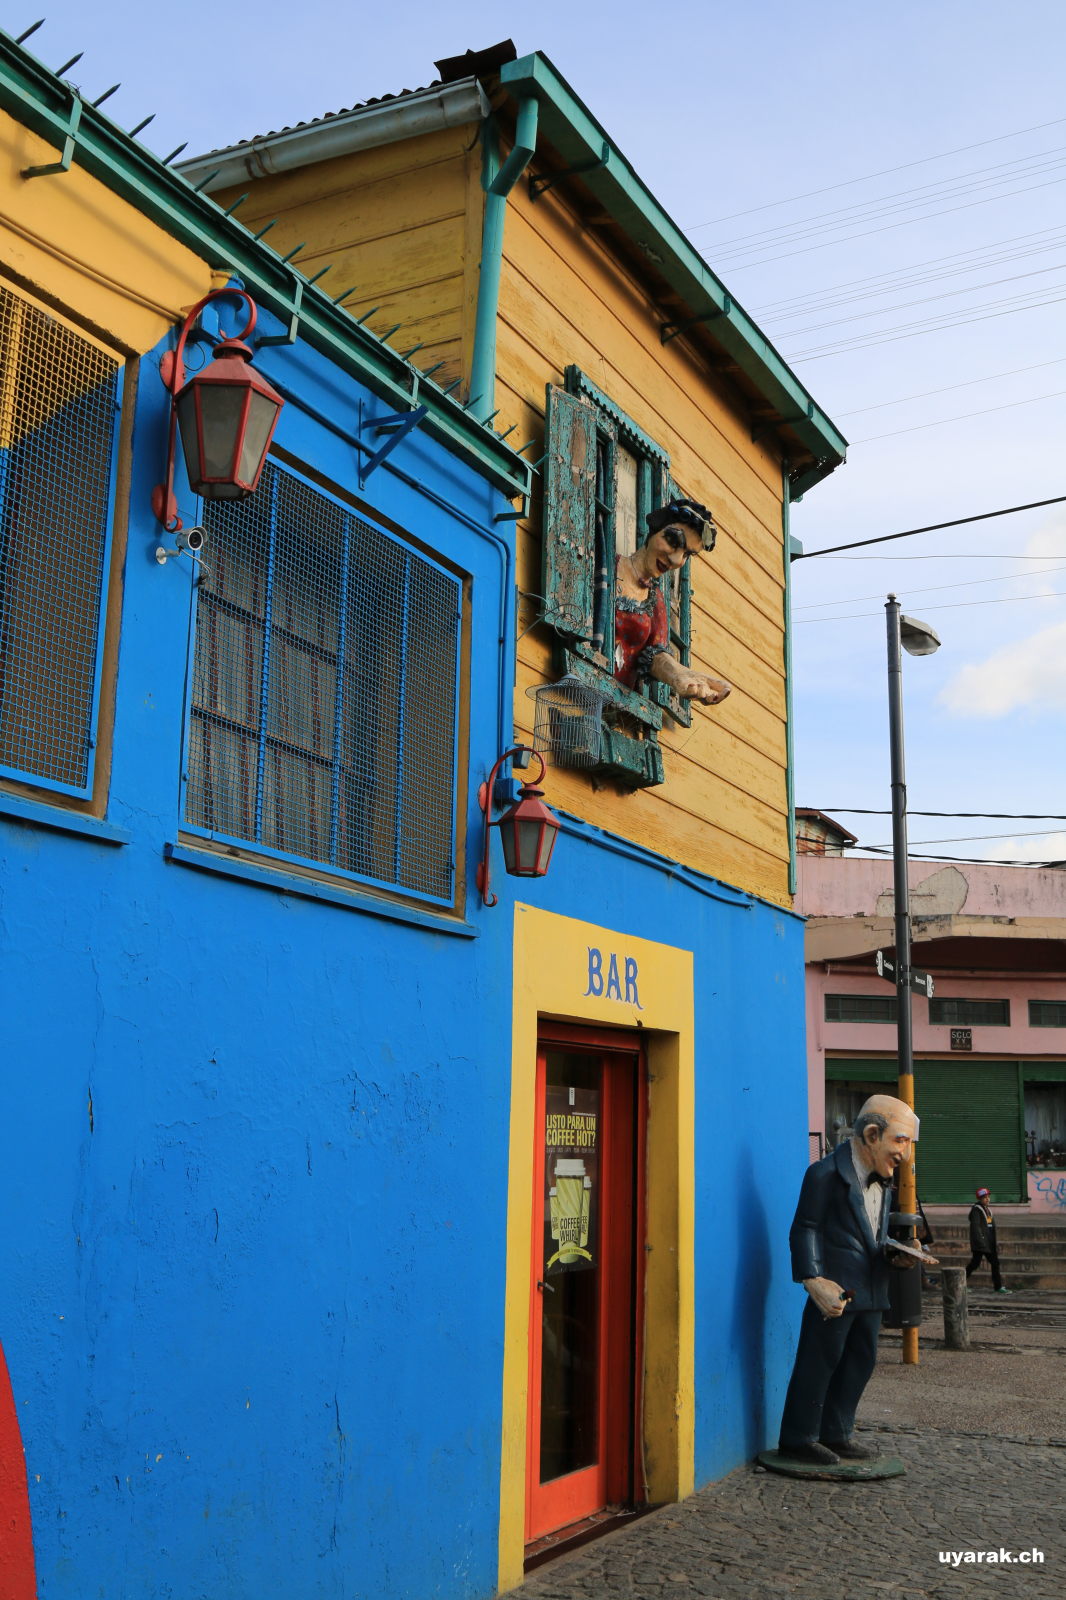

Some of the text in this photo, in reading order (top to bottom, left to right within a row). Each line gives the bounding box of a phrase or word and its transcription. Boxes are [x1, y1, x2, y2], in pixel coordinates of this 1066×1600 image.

[583, 946, 643, 1010] BAR
[546, 1114, 596, 1131] LISTO PARA UN
[546, 1129, 596, 1147] COFFEE HOT?
[560, 1217, 580, 1230] COFFEE
